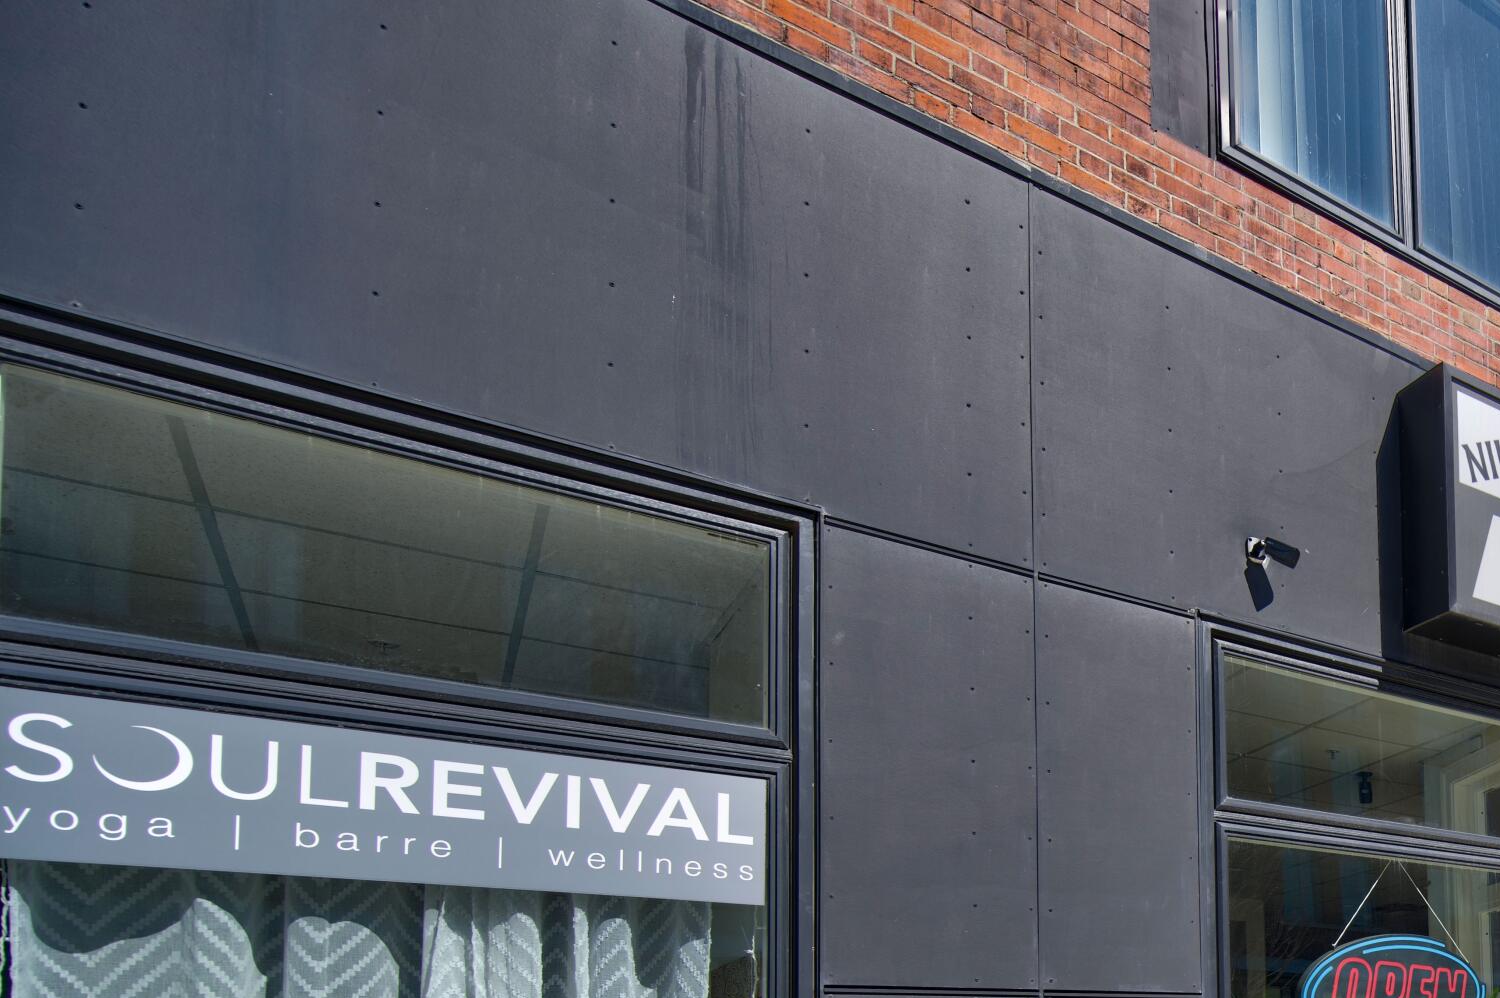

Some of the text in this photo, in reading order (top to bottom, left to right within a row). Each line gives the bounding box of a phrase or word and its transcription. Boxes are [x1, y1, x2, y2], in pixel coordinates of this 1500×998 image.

[2, 805, 755, 882] yoga barre wellness
